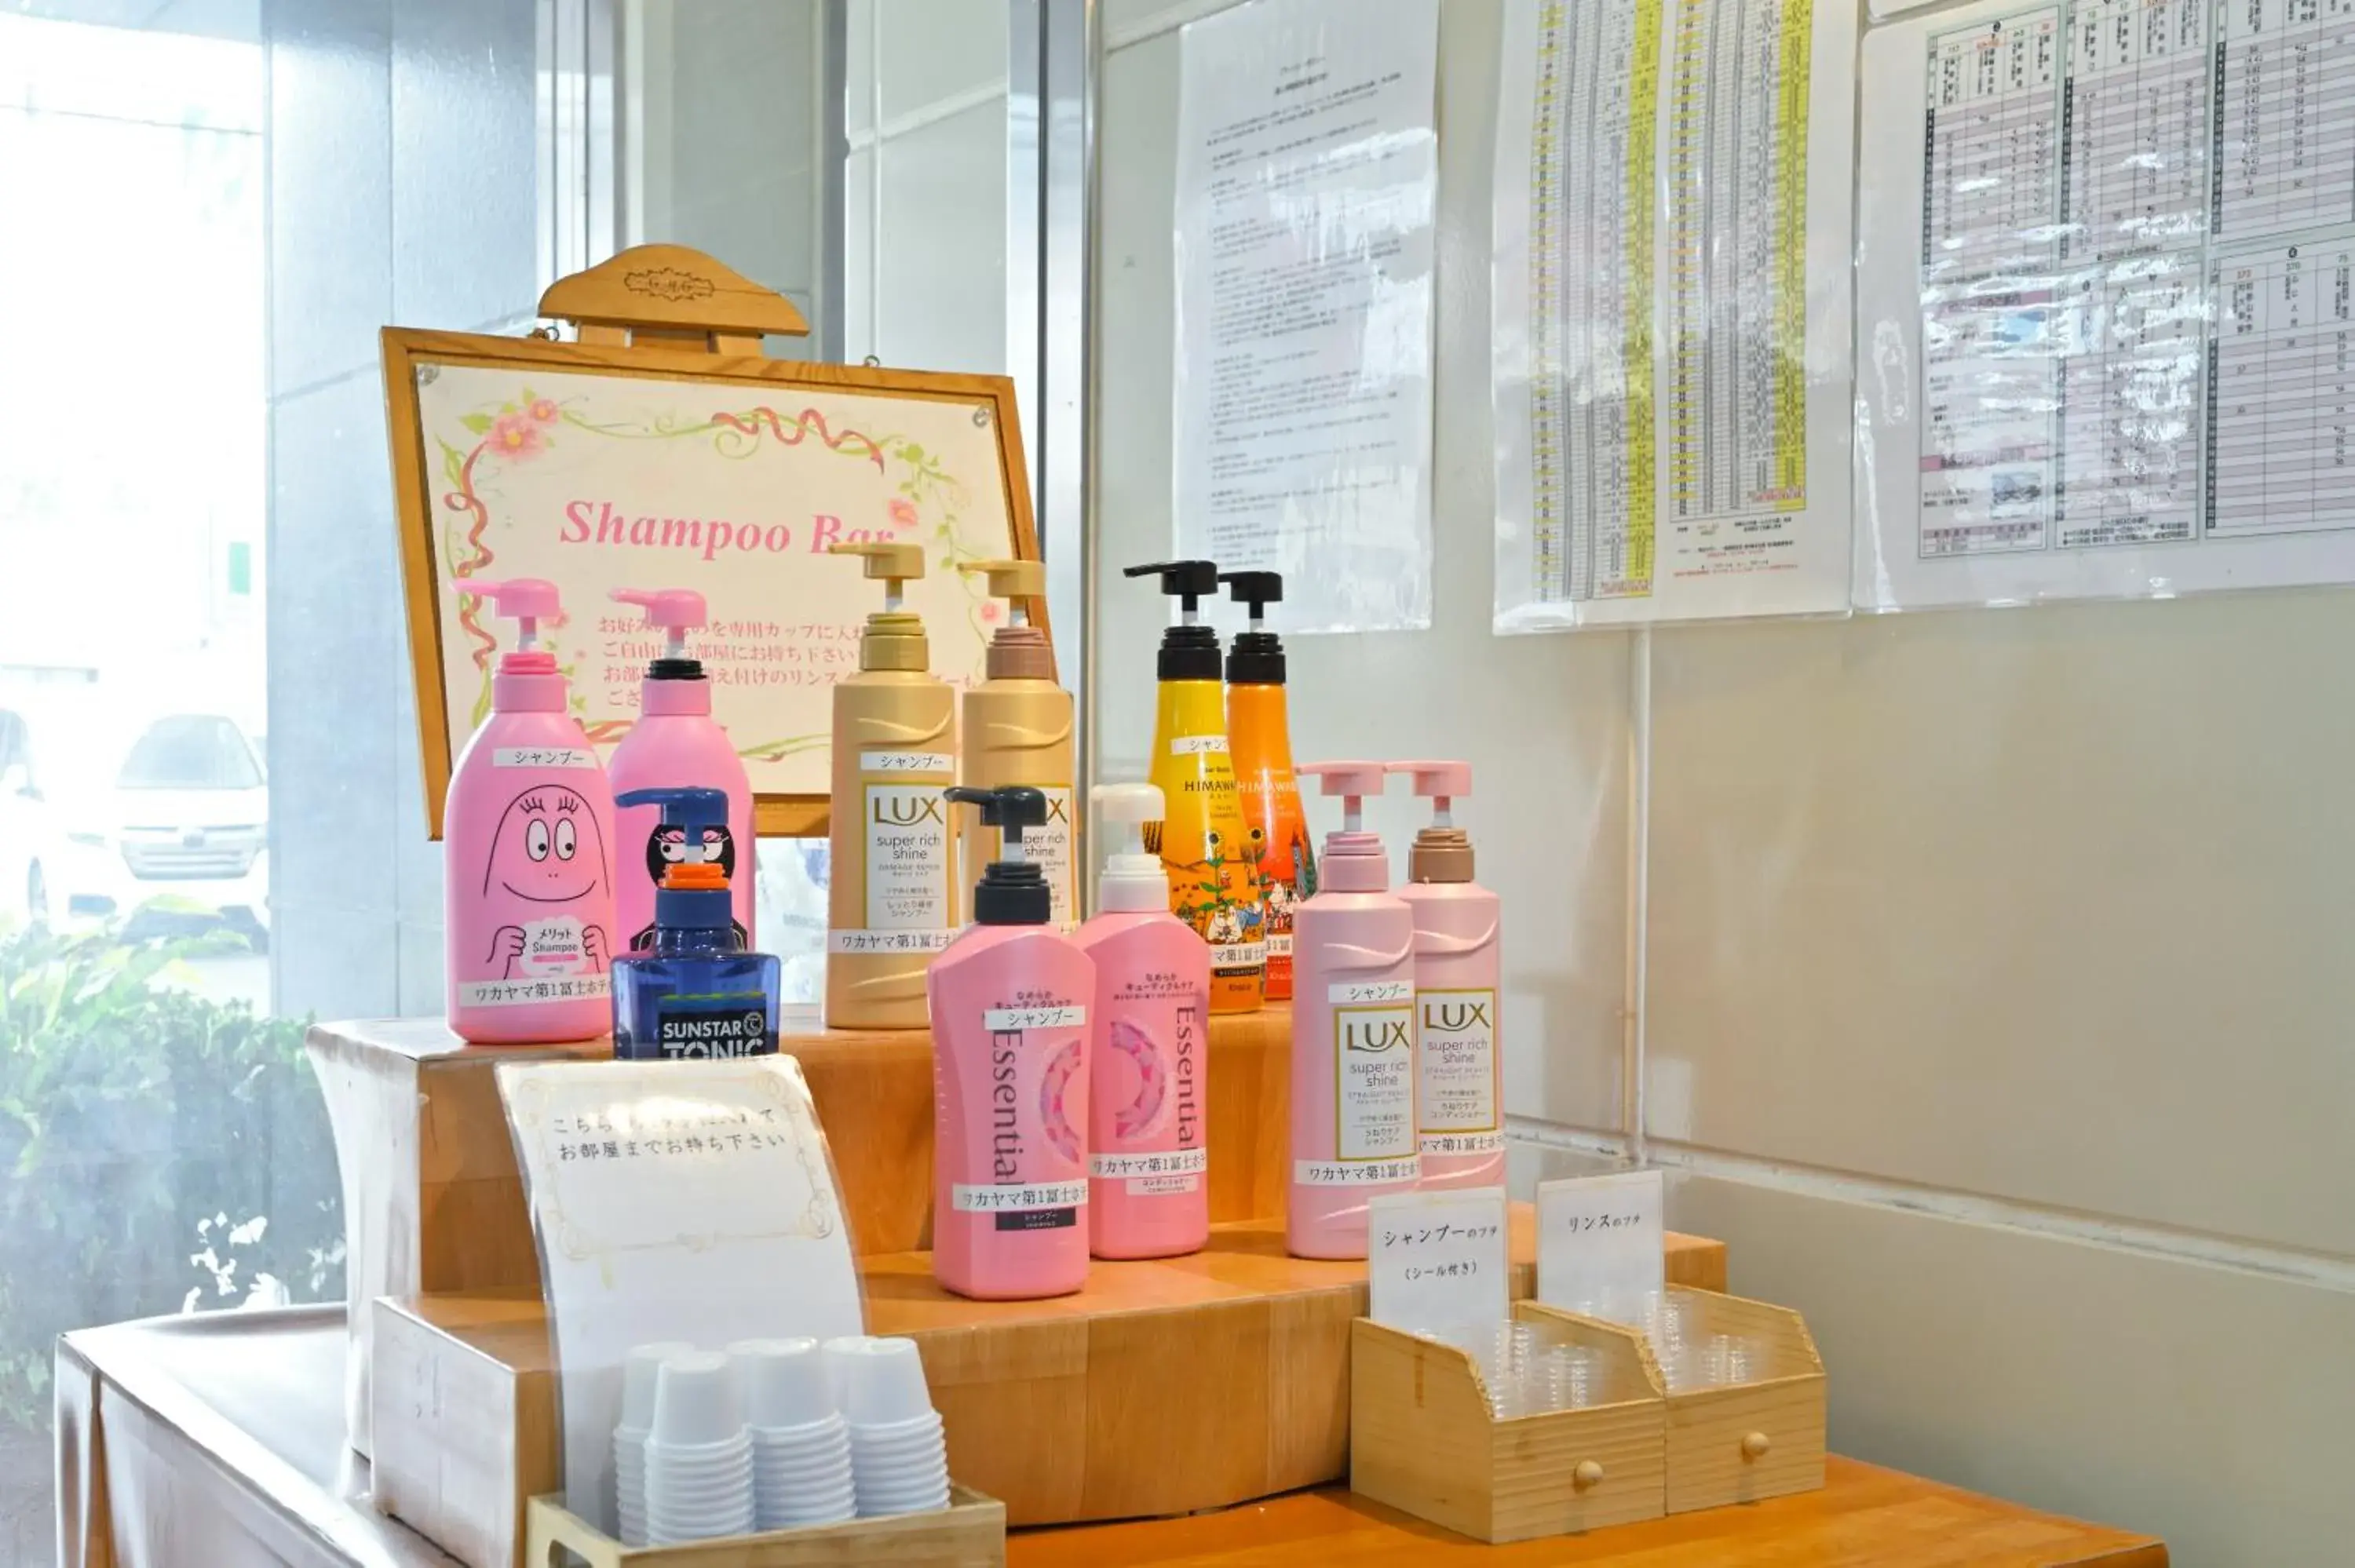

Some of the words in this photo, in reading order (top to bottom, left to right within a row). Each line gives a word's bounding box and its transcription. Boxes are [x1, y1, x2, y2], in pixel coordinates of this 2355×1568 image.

[560, 500, 791, 561] Shampoo
[514, 751, 585, 764] シャンプー
[880, 755, 944, 768] シャンプー
[873, 796, 944, 826] LUX
[876, 834, 917, 848] super
[919, 833, 940, 846] rich
[893, 847, 927, 859] shine
[1024, 847, 1056, 857] shine
[539, 928, 572, 941] メリット
[531, 941, 579, 954] Shampoo
[1349, 983, 1408, 1001] シャンプー
[1008, 1009, 1074, 1026] シャンプー
[1424, 1002, 1492, 1032] LUX
[663, 1019, 743, 1039] SUNSTAR
[1346, 1021, 1411, 1052] LUX
[1426, 1041, 1464, 1052] super
[1466, 1038, 1488, 1051] rich
[1442, 1052, 1476, 1064] shine
[1349, 1063, 1387, 1076] super
[1176, 1005, 1199, 1152] Essential
[1366, 1074, 1399, 1088] shine
[992, 1029, 1026, 1186] Essential
[560, 1132, 786, 1161] お部屋までお持ち下さい
